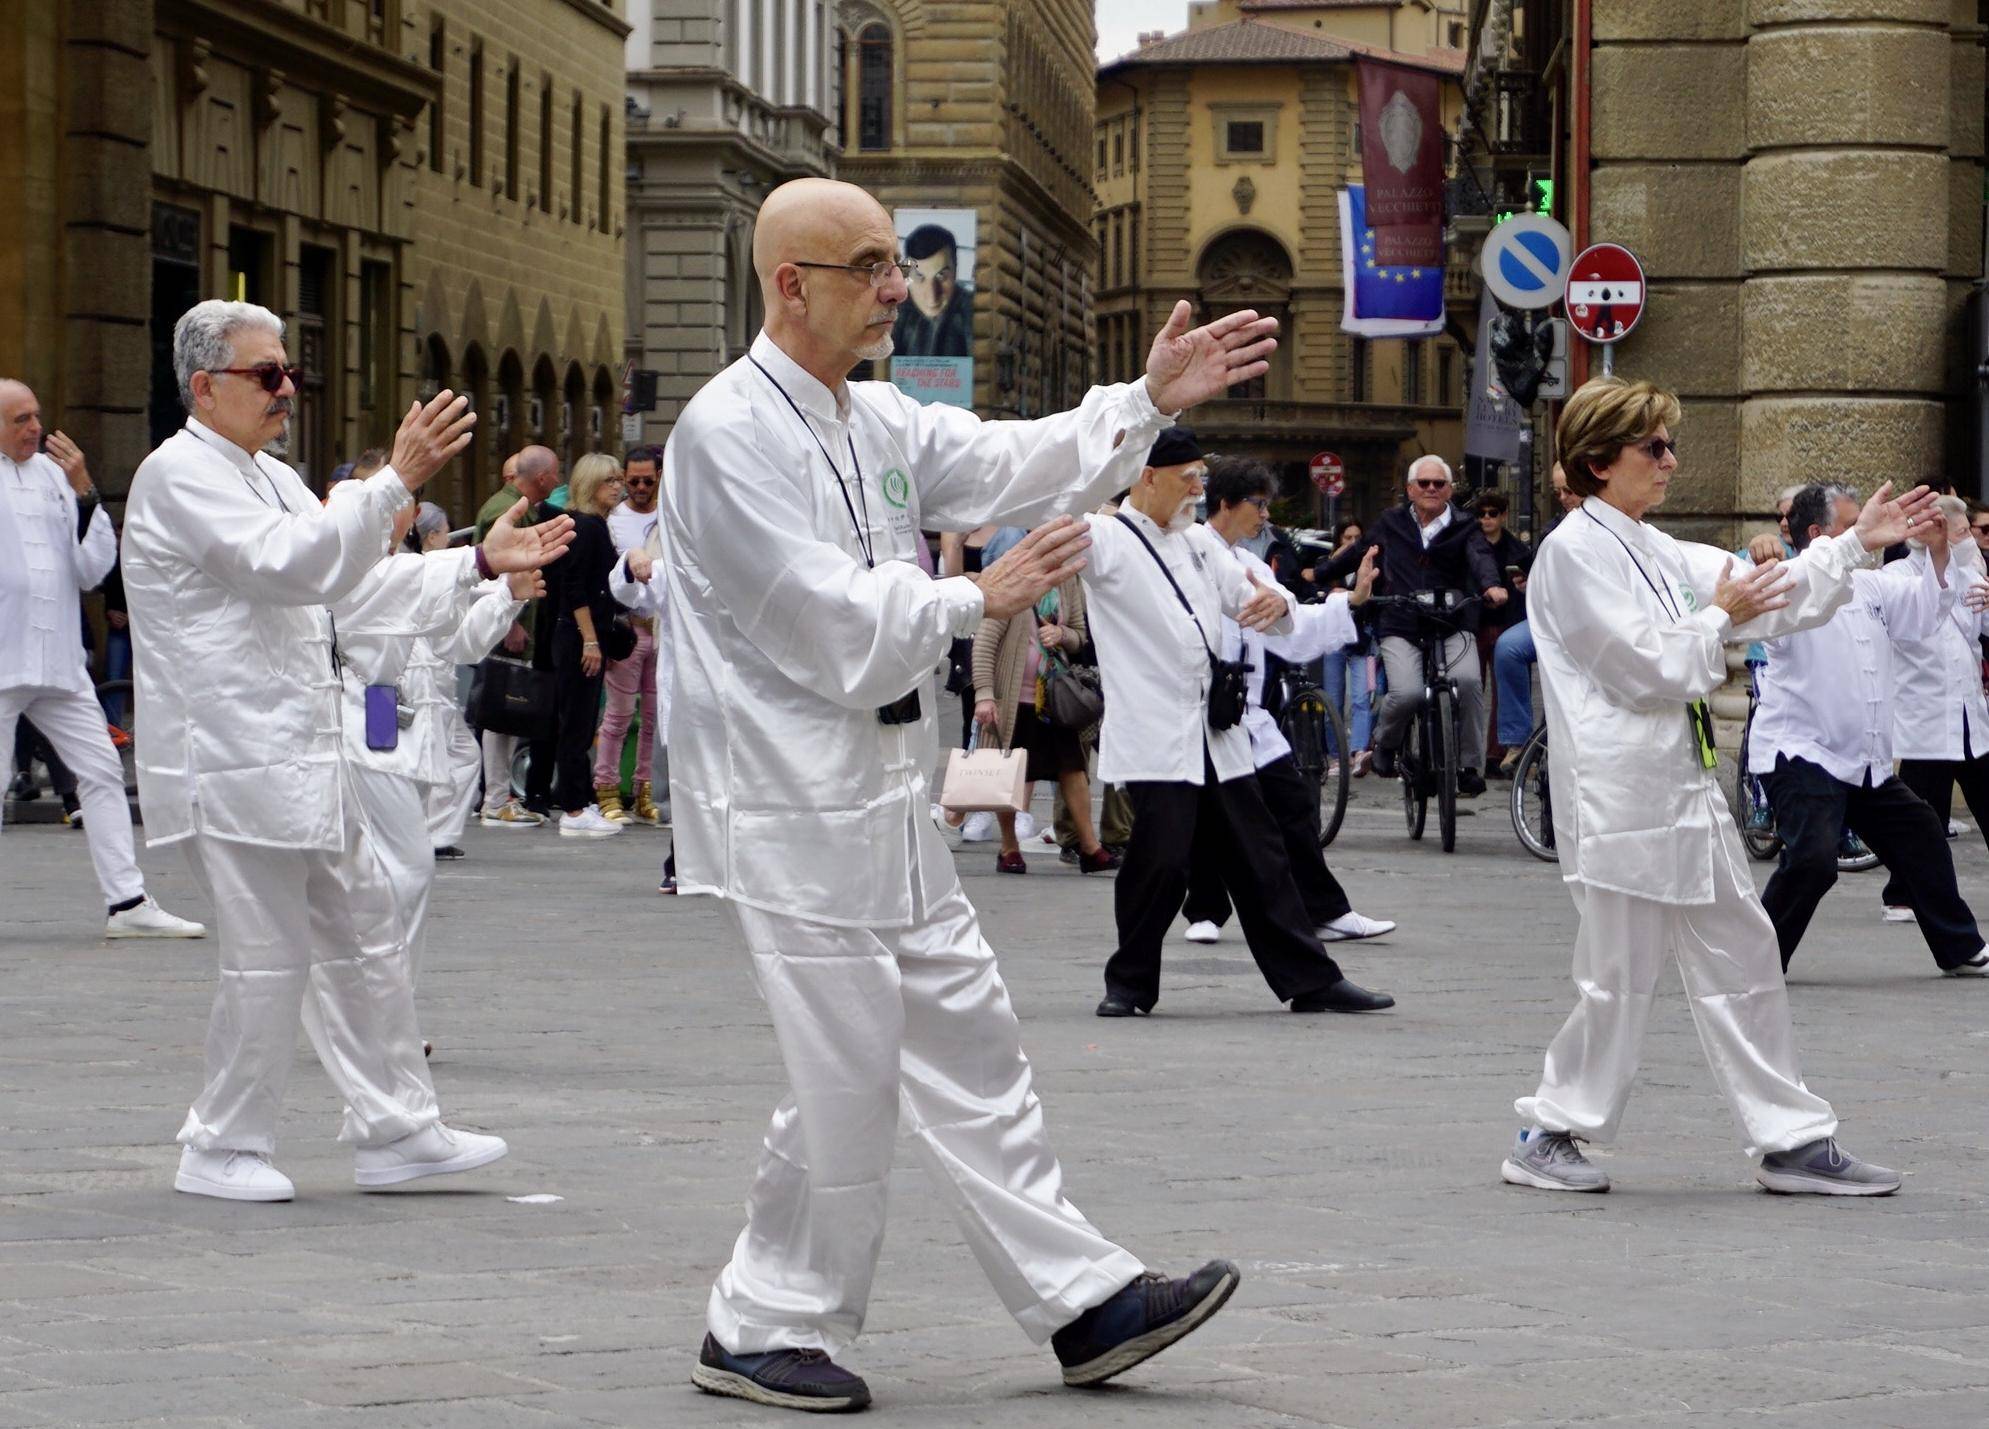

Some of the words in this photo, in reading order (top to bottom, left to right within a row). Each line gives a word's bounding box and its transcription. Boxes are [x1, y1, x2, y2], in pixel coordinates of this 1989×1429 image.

[1377, 187, 1433, 200] PALAZZO
[1368, 200, 1442, 214] VECCHIETTI
[1383, 235, 1433, 247] PALAZZO
[895, 367, 937, 377] REACHING
[939, 367, 957, 378] FOR
[917, 378, 933, 388] THE
[935, 378, 961, 389] STARS
[1476, 413, 1518, 425] HOTELS
